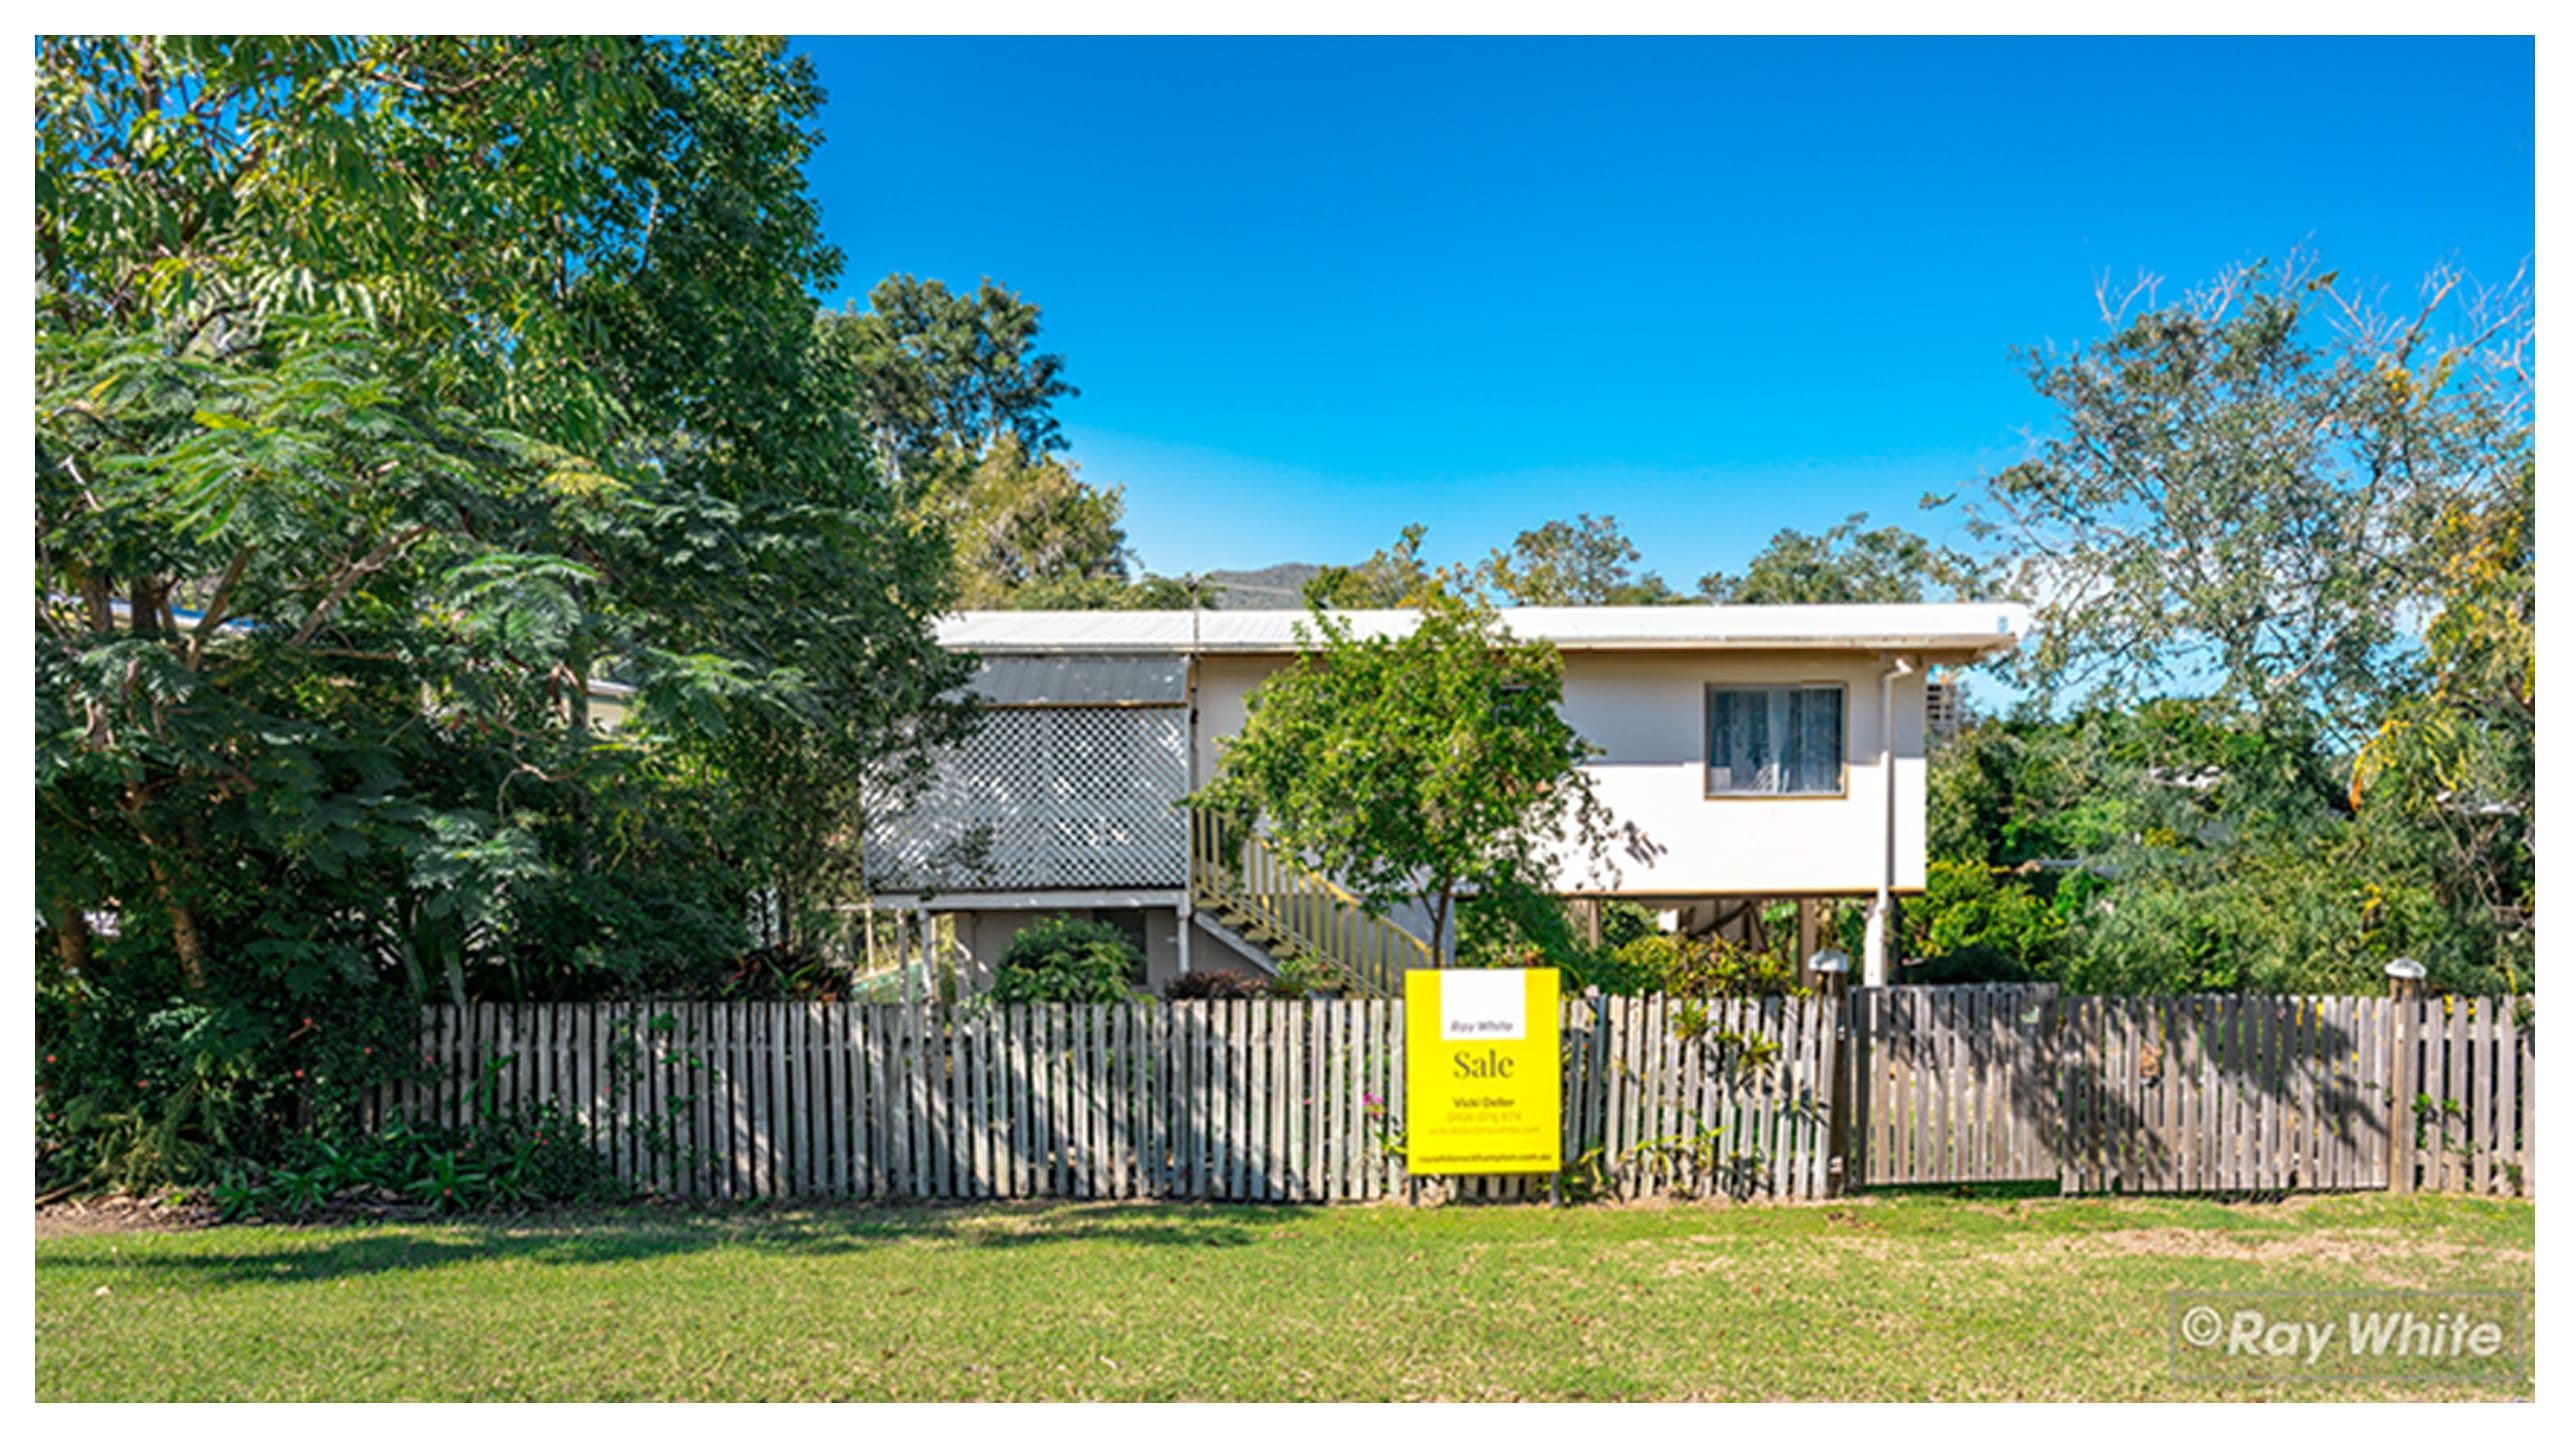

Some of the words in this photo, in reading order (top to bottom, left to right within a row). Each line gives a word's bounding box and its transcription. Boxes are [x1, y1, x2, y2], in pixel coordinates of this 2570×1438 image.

[1451, 1020, 1474, 1033] Ray
[1478, 1020, 1513, 1031] White
[1453, 1048, 1515, 1080] Sale
